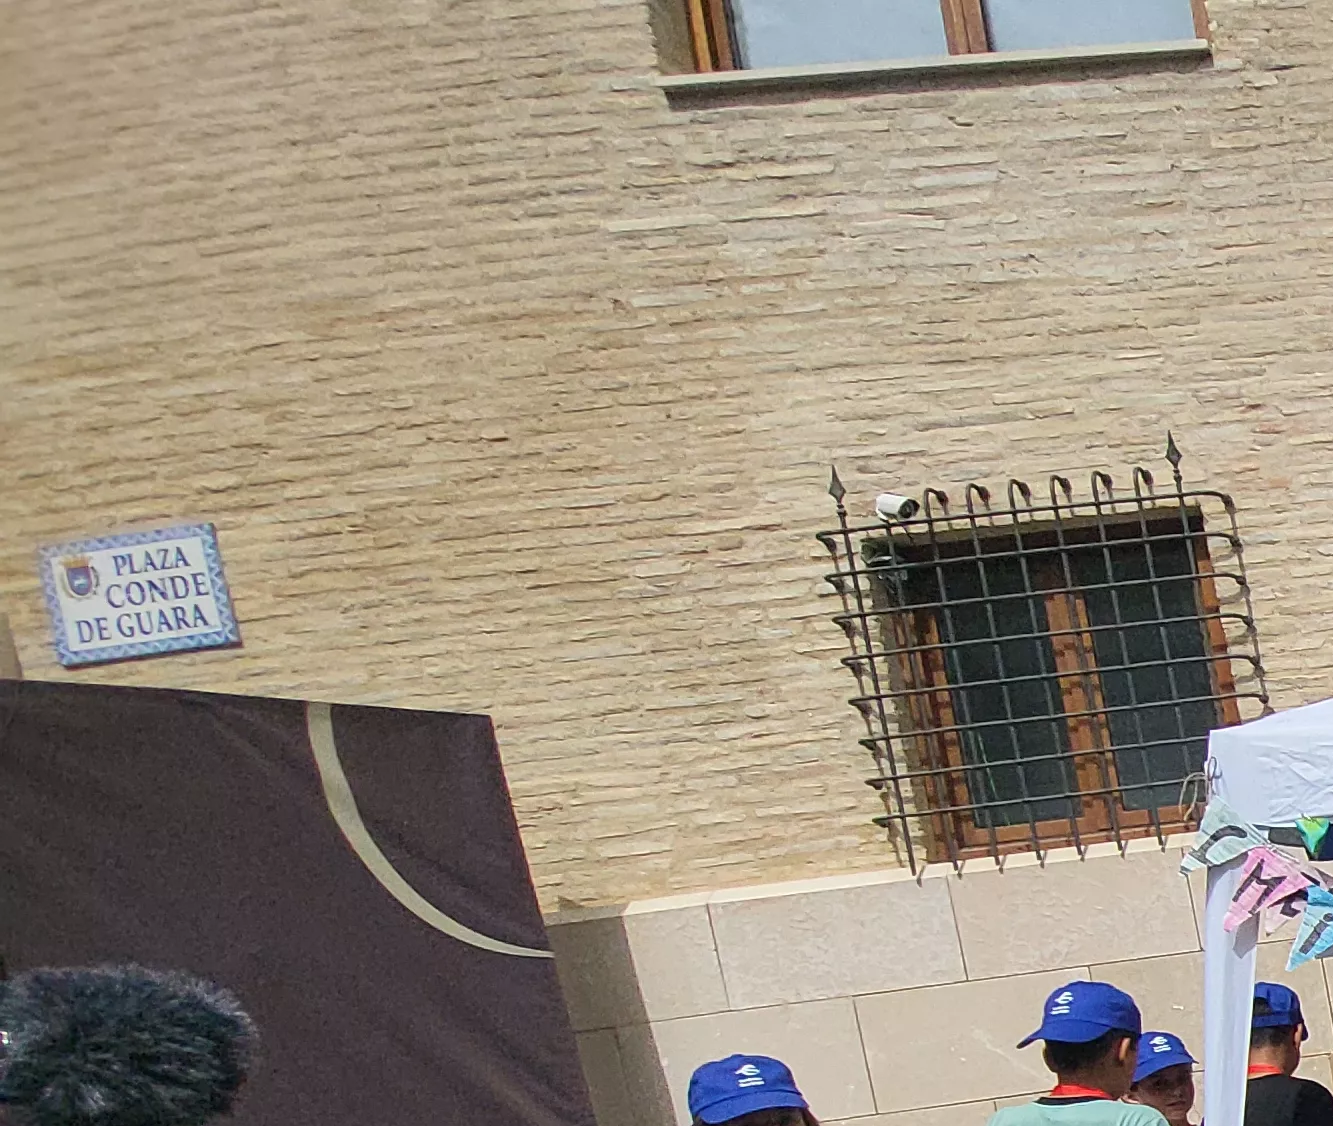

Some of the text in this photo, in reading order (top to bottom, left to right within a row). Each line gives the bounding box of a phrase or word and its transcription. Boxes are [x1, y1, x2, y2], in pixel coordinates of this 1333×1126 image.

[112, 546, 191, 577] PLAZA
[105, 572, 210, 609] CONDE
[75, 604, 210, 644] DE GUARA
